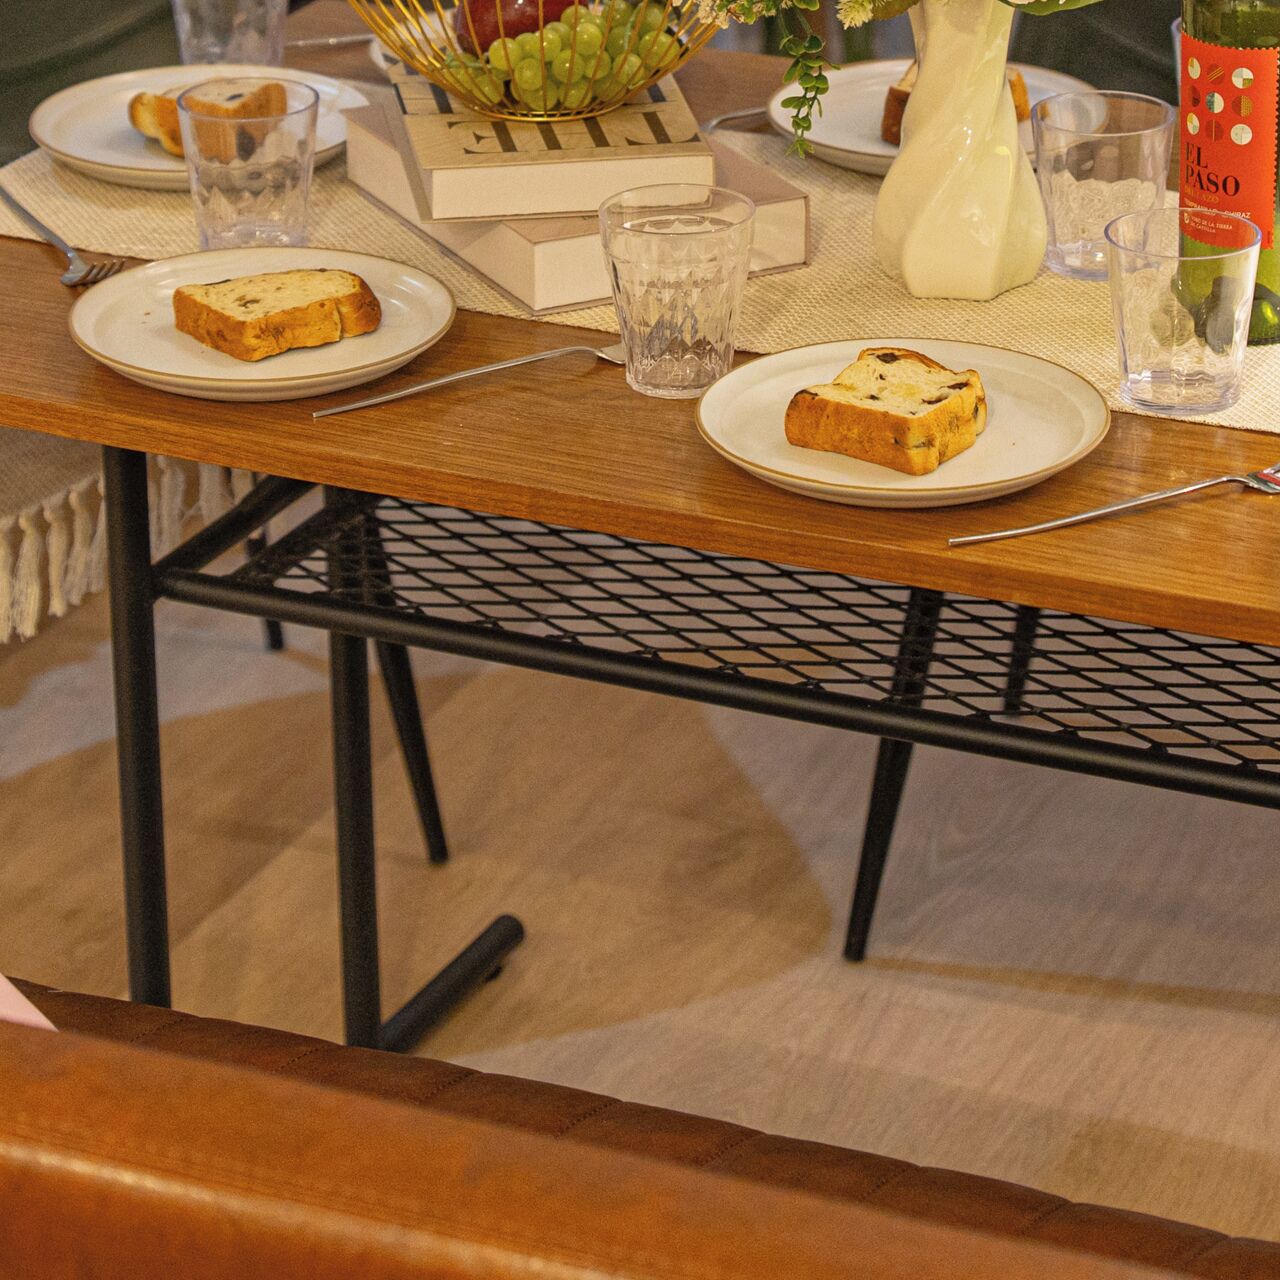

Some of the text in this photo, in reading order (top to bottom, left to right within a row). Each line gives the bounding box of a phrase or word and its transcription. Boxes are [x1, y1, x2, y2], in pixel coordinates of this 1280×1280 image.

[447, 111, 701, 155] THE
[1186, 142, 1208, 169] EL
[1186, 164, 1240, 196] PASO
